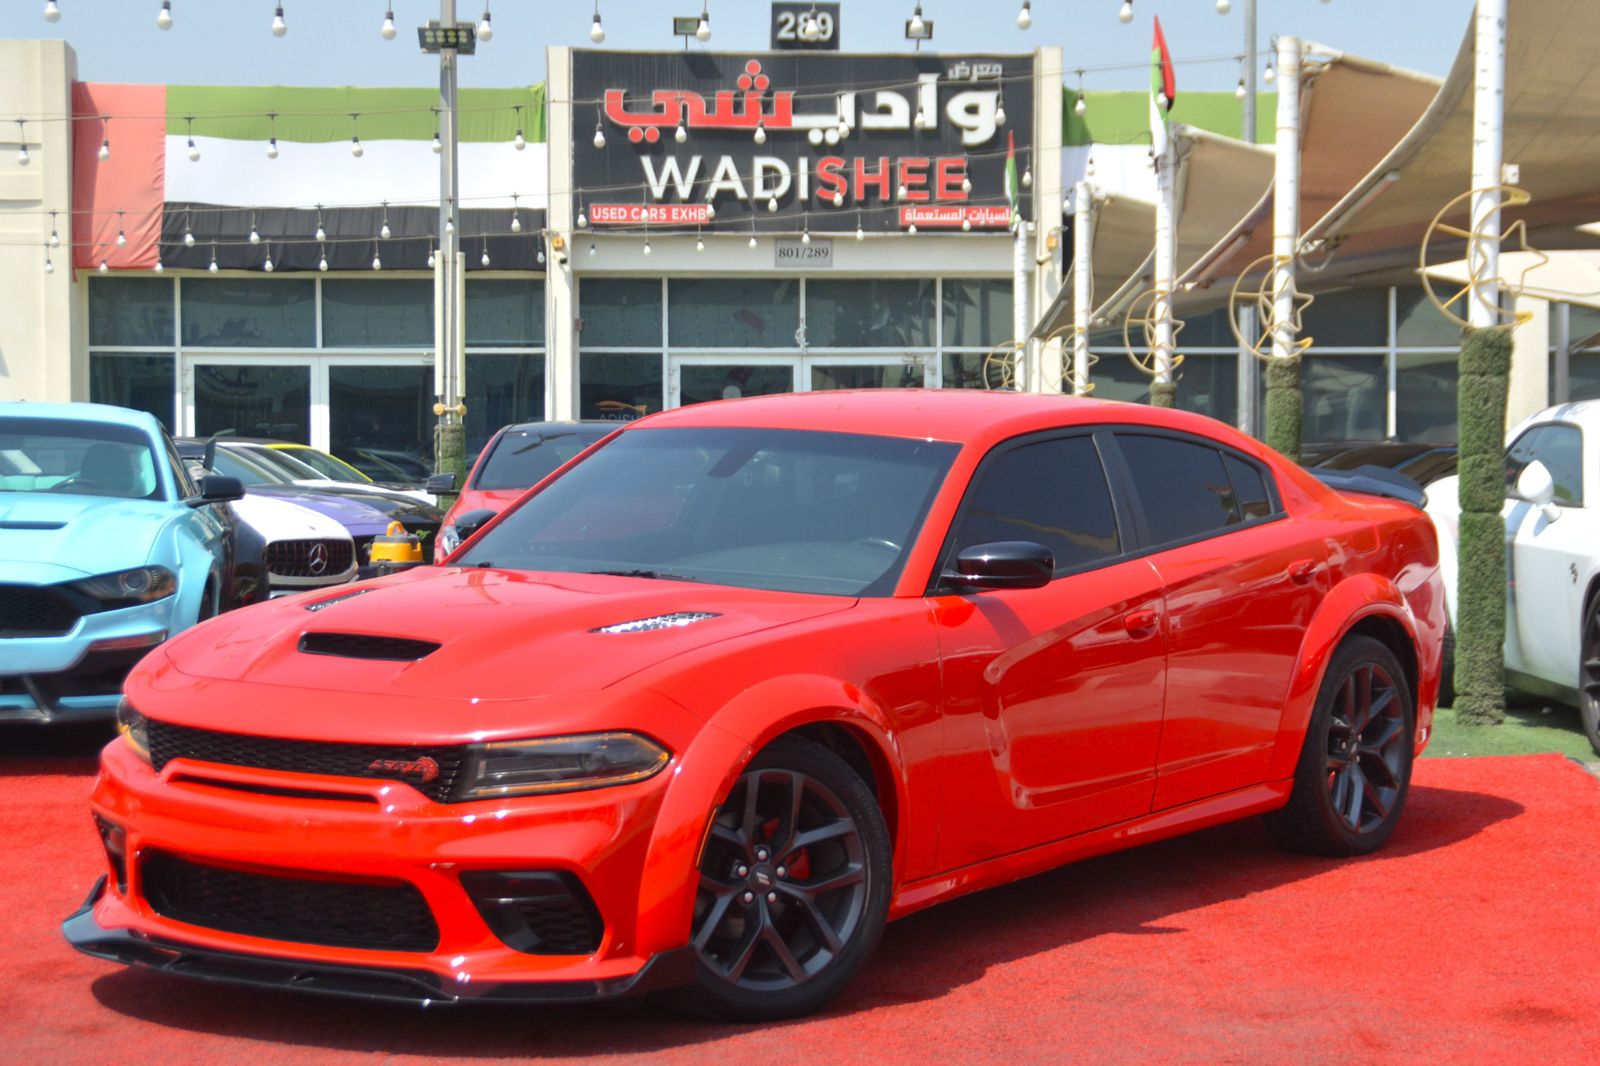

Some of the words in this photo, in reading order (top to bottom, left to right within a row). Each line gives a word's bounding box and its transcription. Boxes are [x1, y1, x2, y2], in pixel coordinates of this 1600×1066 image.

[777, 11, 834, 41] 289
[592, 207, 628, 220] USED
[631, 207, 667, 220] CRS
[778, 247, 830, 259] 801/289
